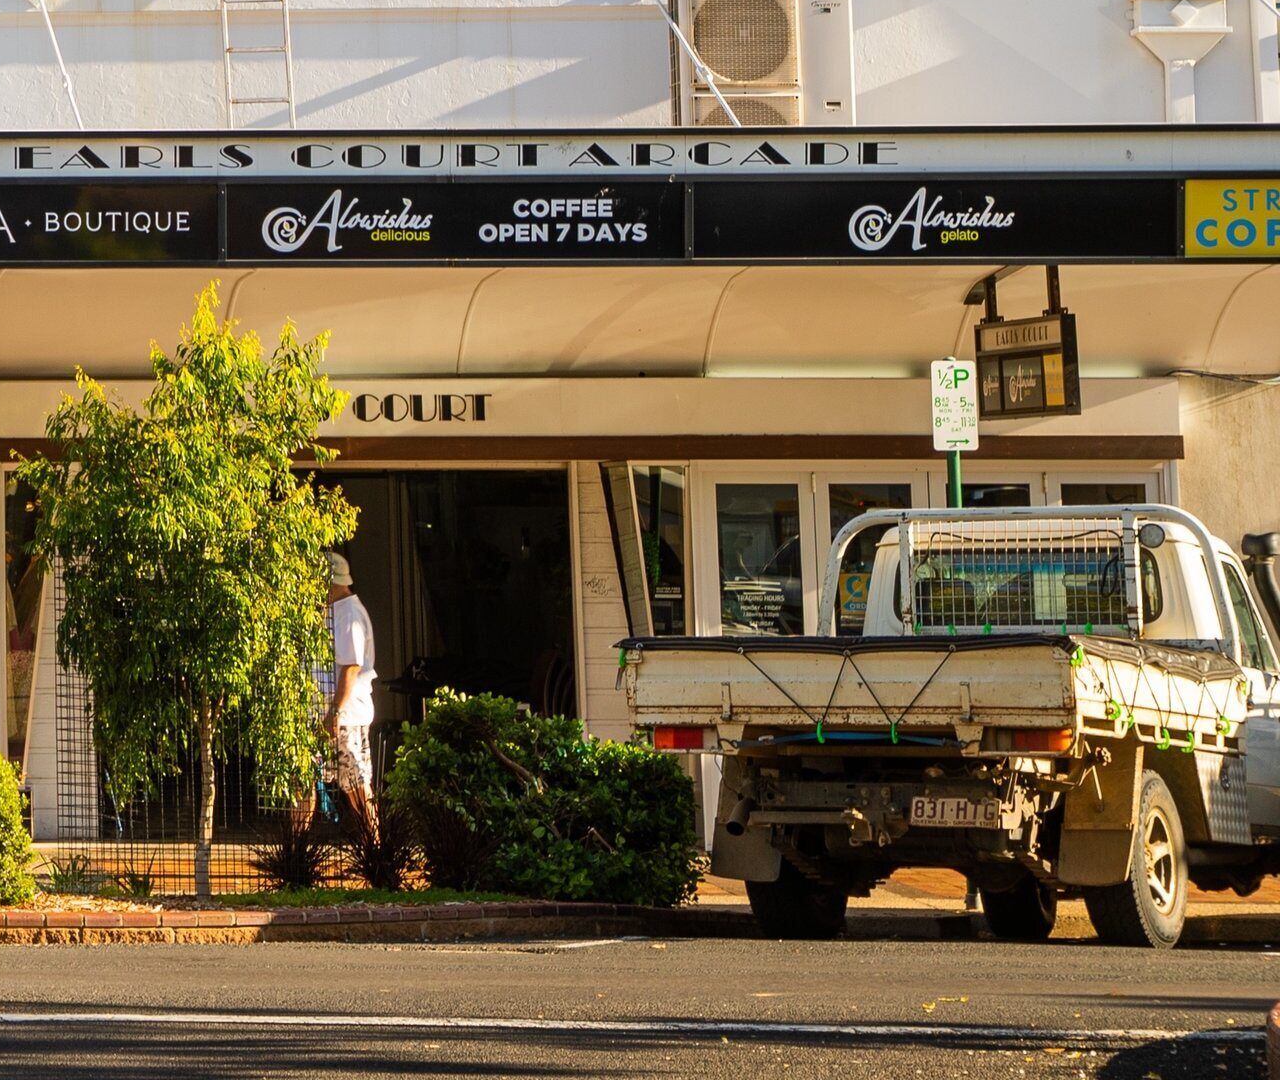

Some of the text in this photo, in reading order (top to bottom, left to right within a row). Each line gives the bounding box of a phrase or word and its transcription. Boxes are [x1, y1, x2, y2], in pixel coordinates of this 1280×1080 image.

[14, 141, 898, 169] EARLS COURT ARCADE
[513, 198, 614, 218] COFFEE
[848, 186, 1015, 251] Alowishus
[44, 211, 191, 233] BOUTIQUE
[262, 189, 433, 253] Alowishus
[371, 229, 431, 242] delicious
[478, 223, 648, 243] OPEN 7 DAYS
[940, 228, 979, 243] gelato
[352, 393, 493, 423] COURT
[737, 594, 784, 602] TRADING HOURS
